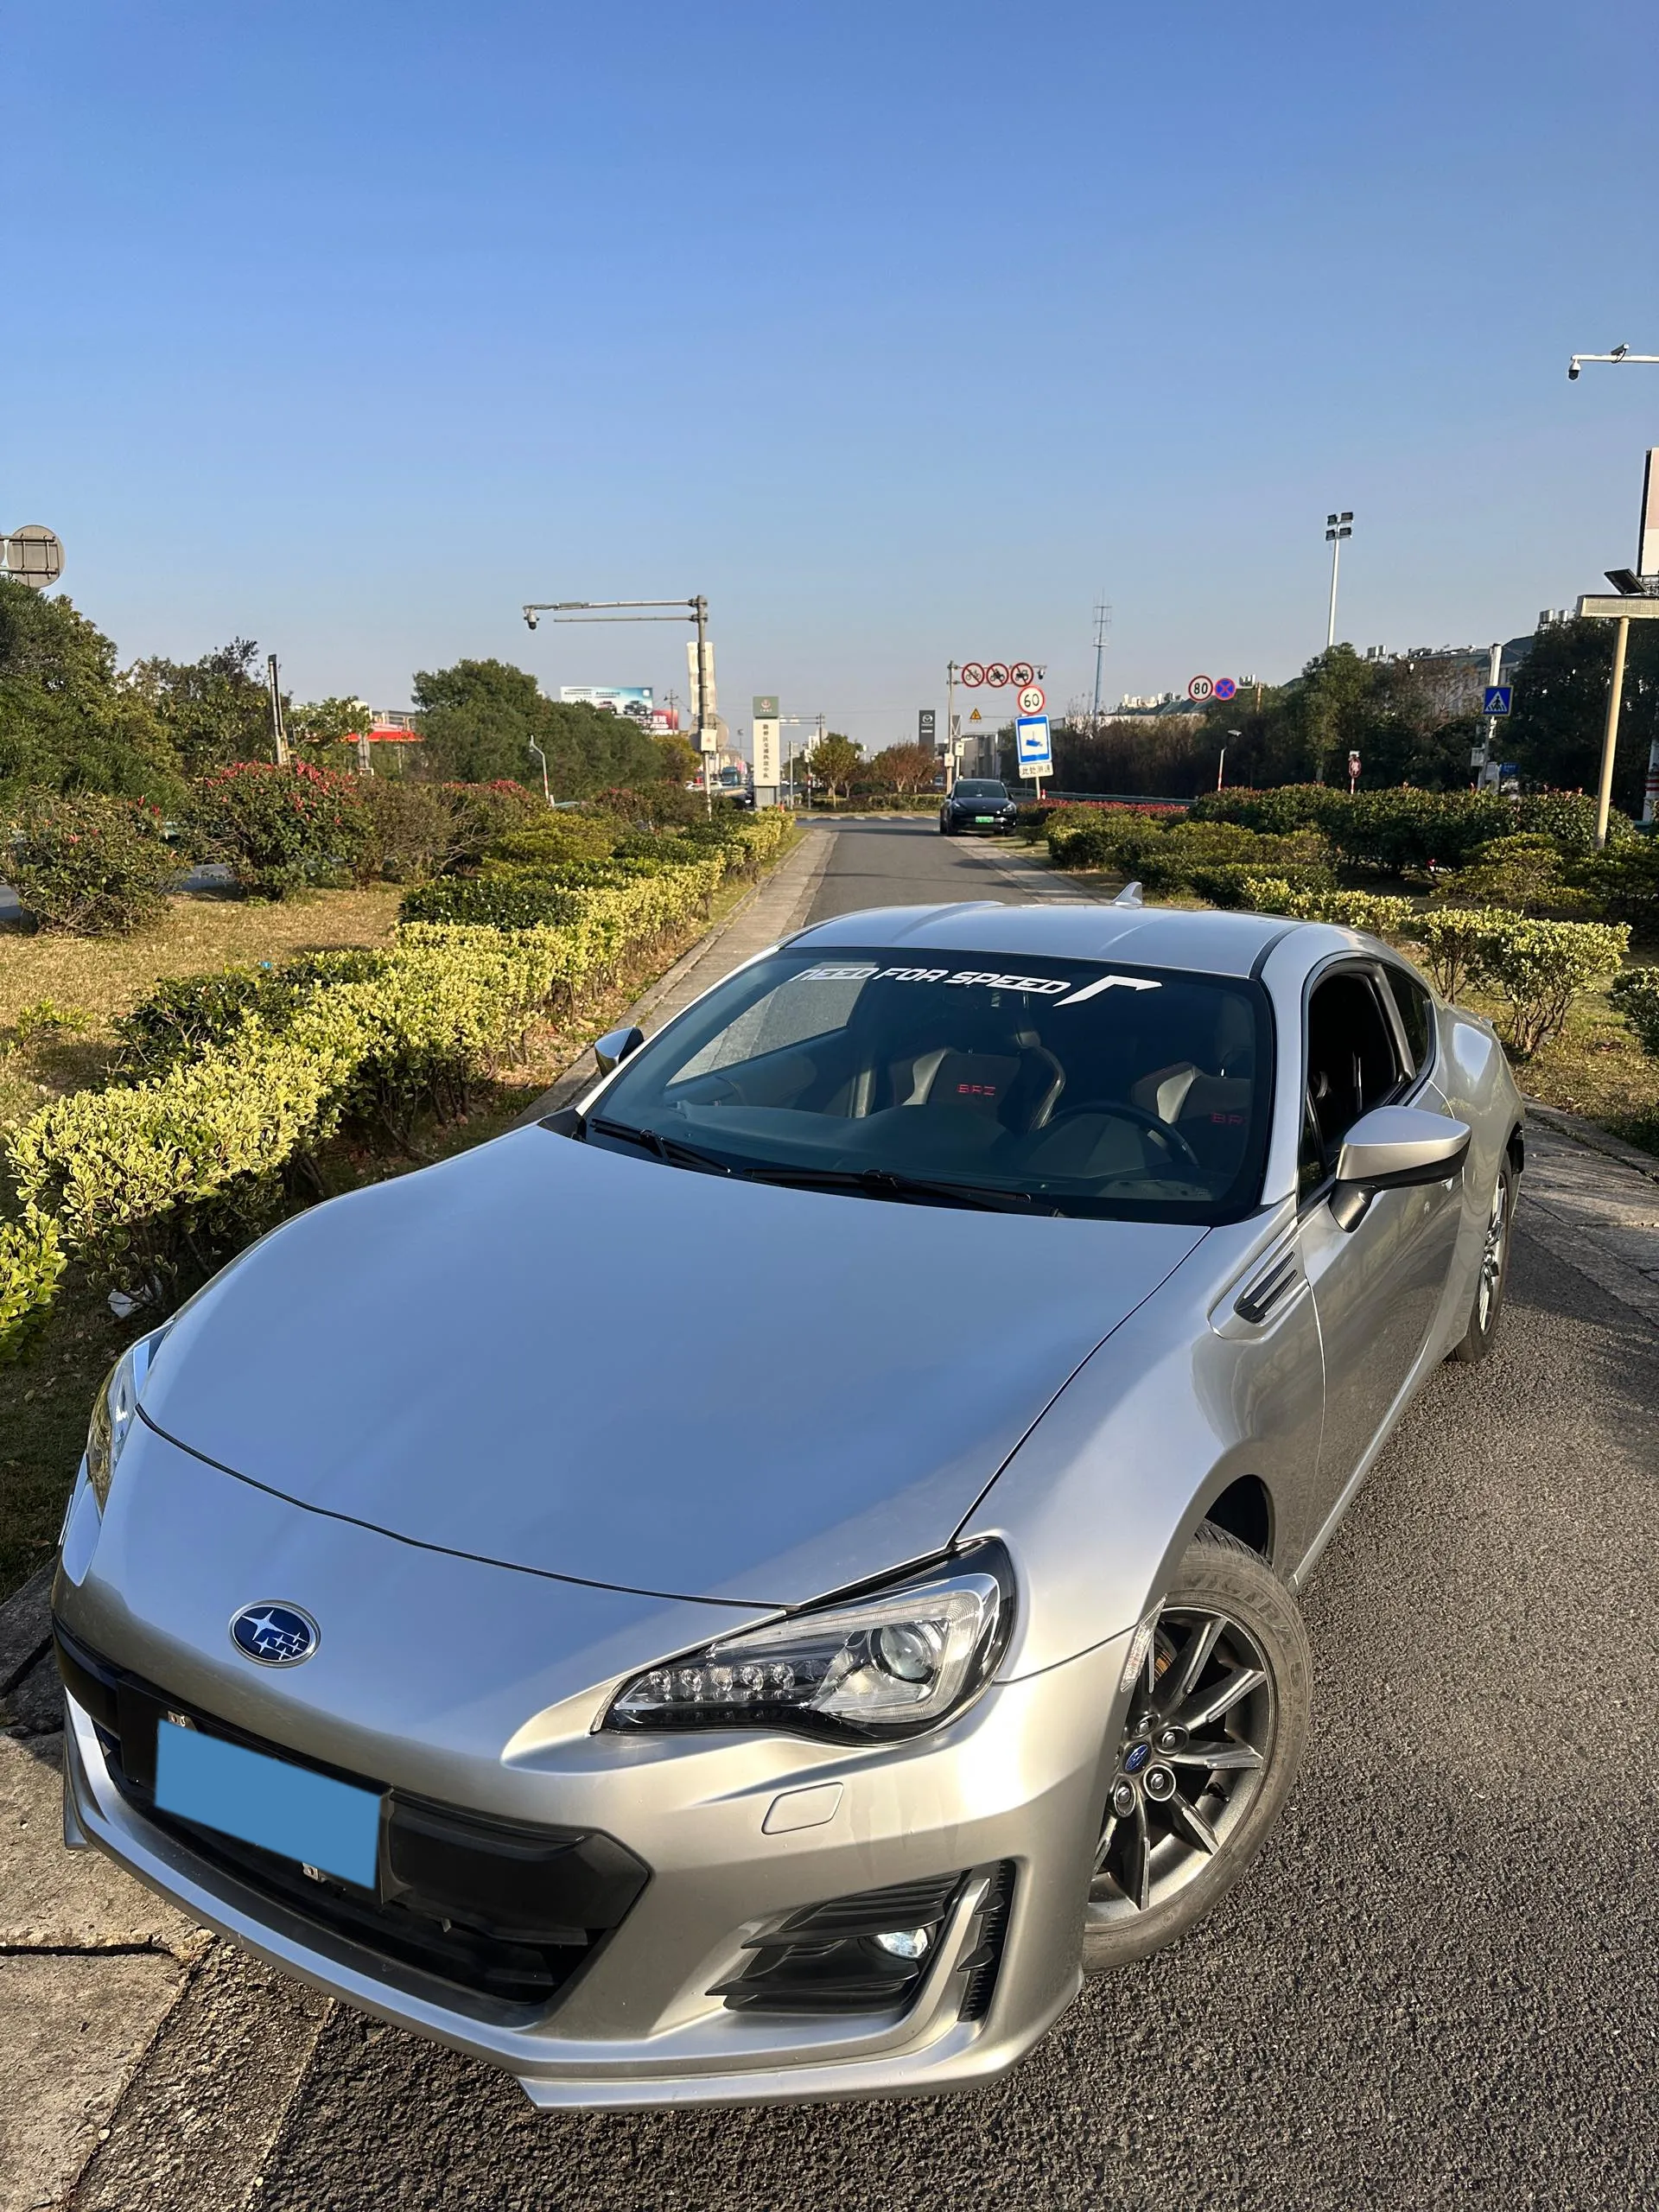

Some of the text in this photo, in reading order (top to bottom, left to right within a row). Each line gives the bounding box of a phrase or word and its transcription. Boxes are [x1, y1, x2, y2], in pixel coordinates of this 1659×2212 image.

[1194, 683, 1208, 695] 80
[1024, 694, 1039, 708] 60
[788, 967, 1071, 995] NEED FOR SPEED
[957, 1084, 996, 1096] BRZ
